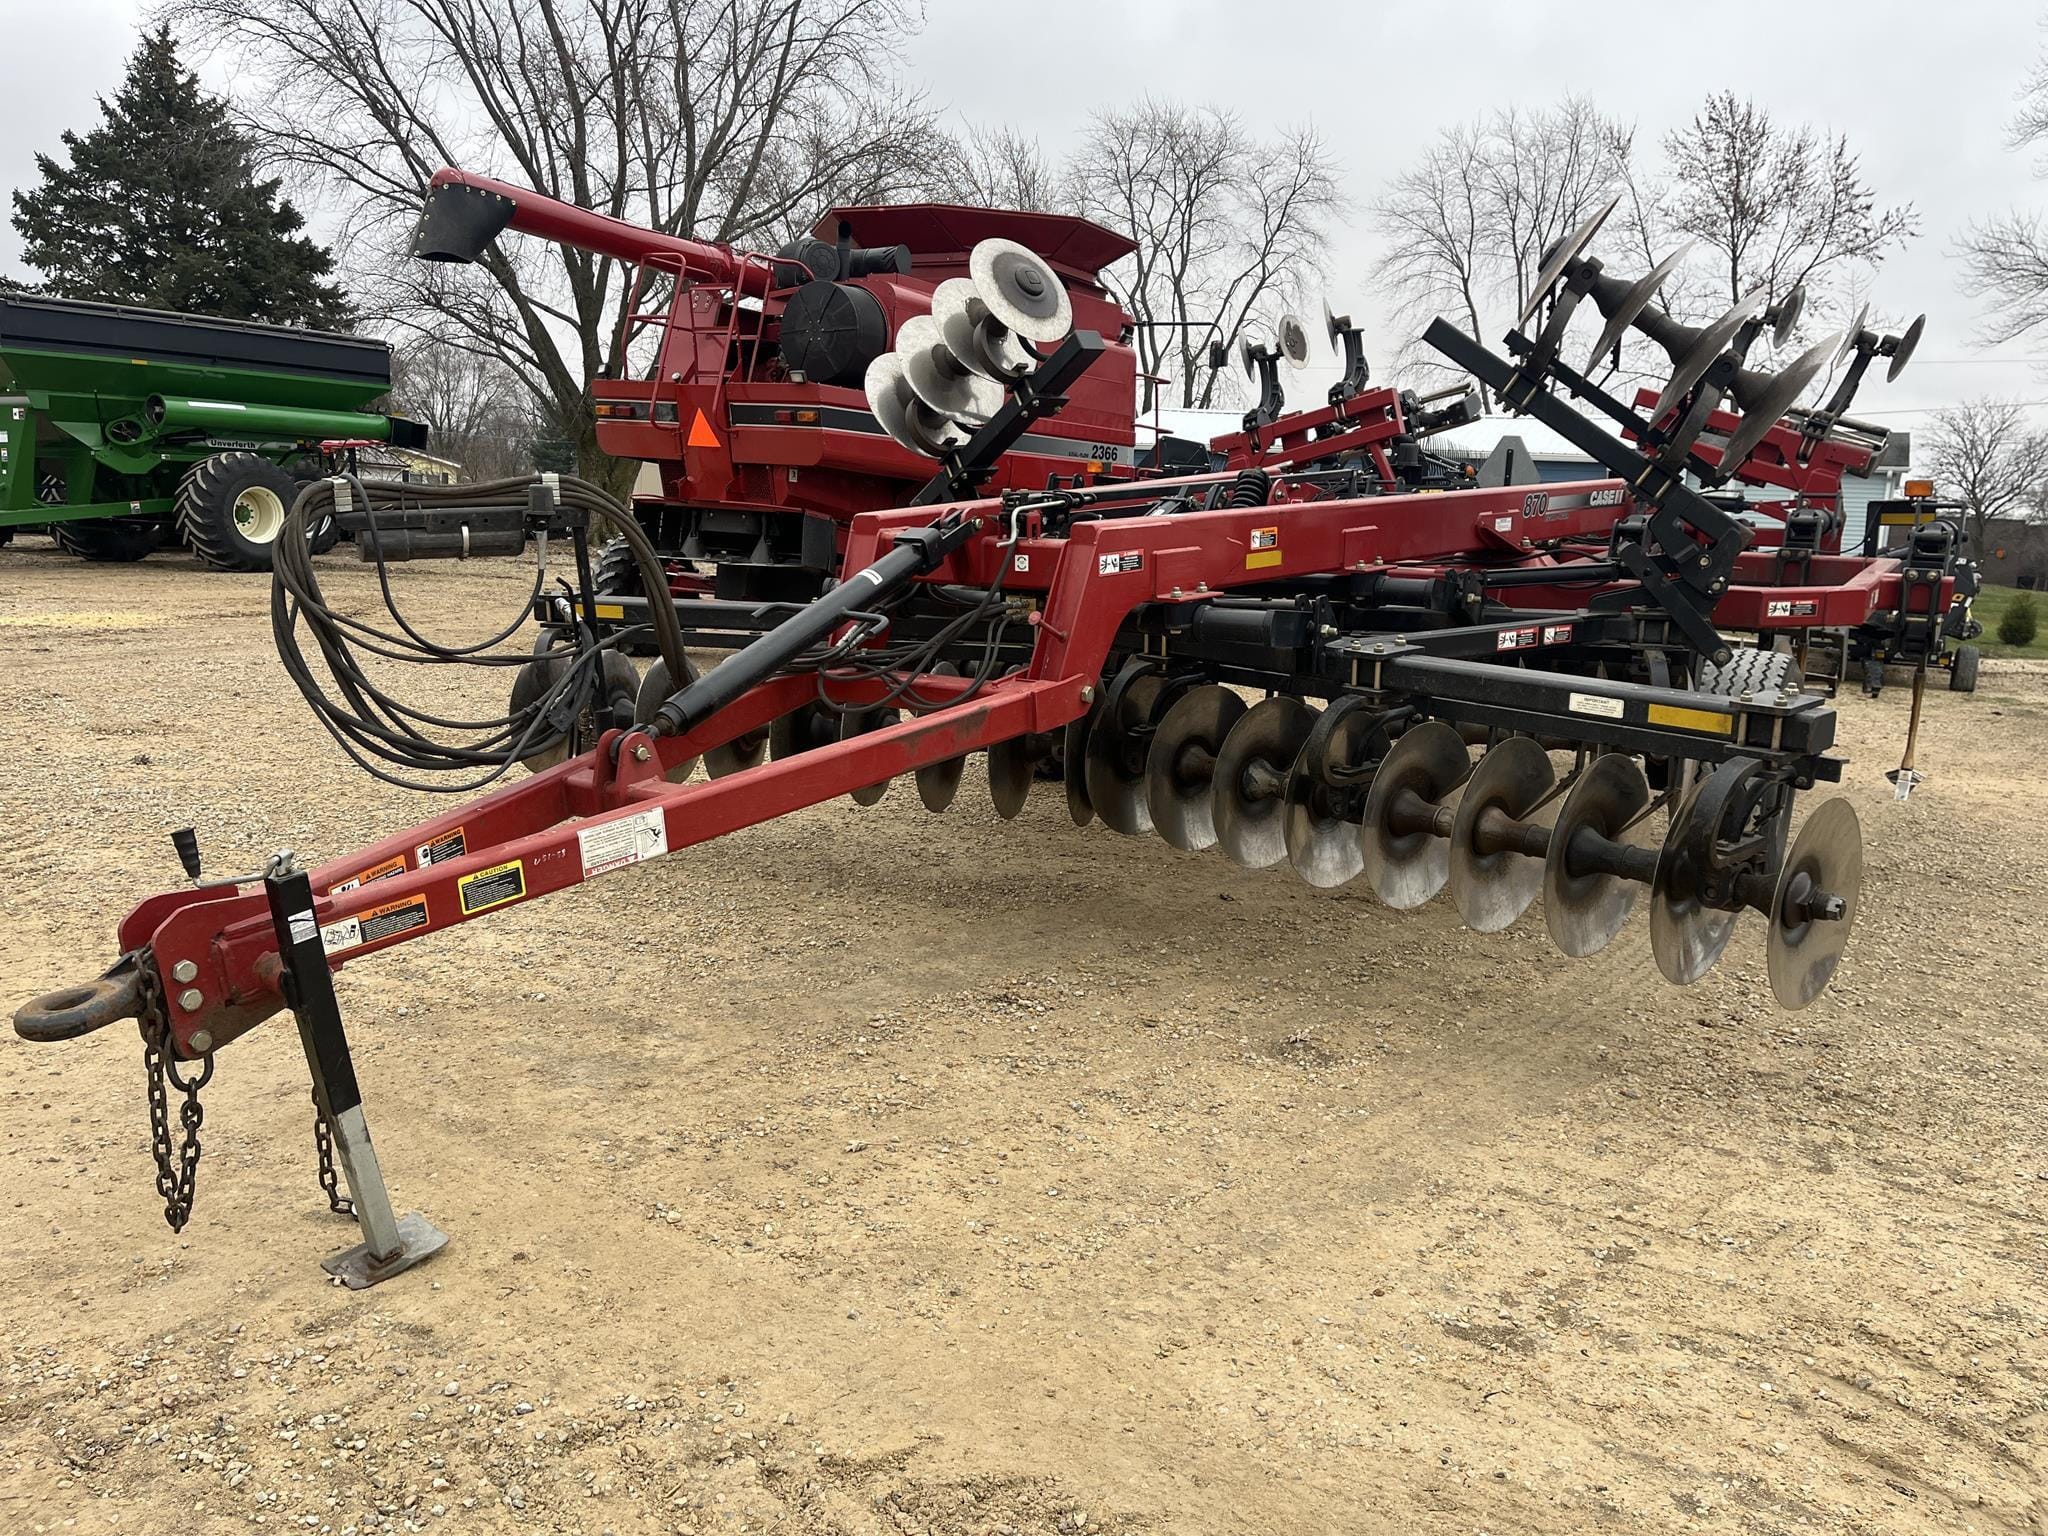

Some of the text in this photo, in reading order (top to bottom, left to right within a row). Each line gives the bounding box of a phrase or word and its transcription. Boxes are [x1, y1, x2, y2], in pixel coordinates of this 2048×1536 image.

[1091, 445, 1118, 461] 2366
[1523, 492, 1549, 518] 870
[435, 829, 461, 842] WARNING
[371, 861, 397, 877] WARNING
[480, 864, 508, 877] CAUTION
[592, 859, 627, 875] DANGER
[380, 899, 412, 914] WARNING
